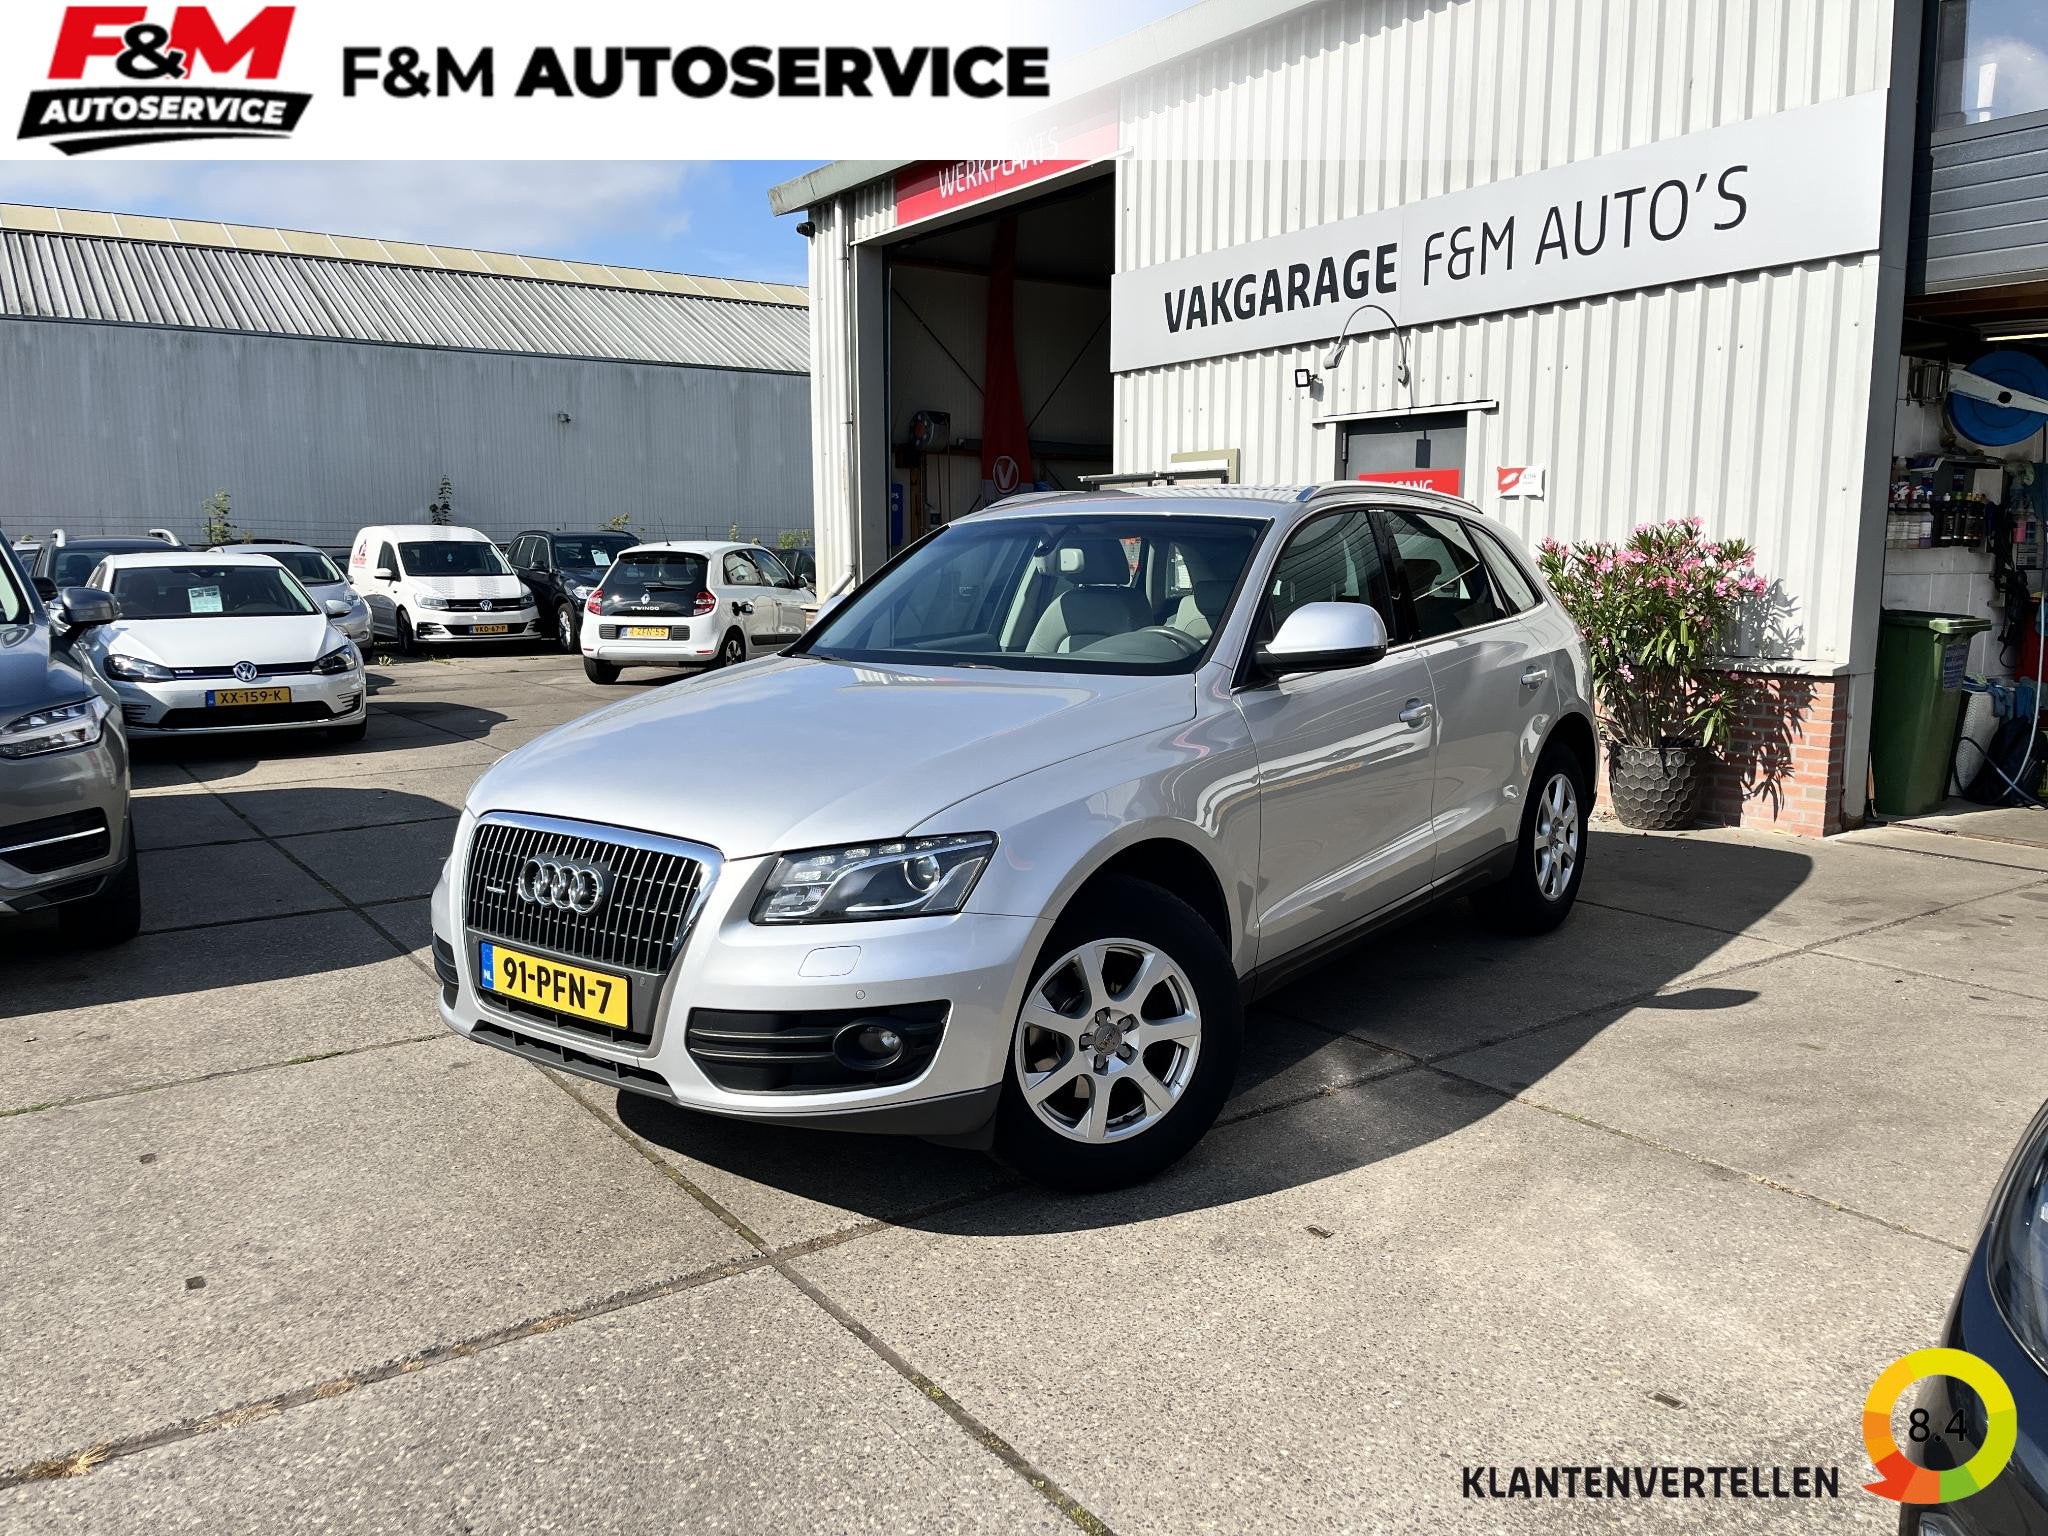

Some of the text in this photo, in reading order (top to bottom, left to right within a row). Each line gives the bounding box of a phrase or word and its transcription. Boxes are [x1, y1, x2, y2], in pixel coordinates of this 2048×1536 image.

[1163, 165, 1748, 334] VAKGARAGE F&M AUTO'S
[220, 690, 282, 705] XX-159-K
[503, 956, 612, 1015] 91-PFN-7
